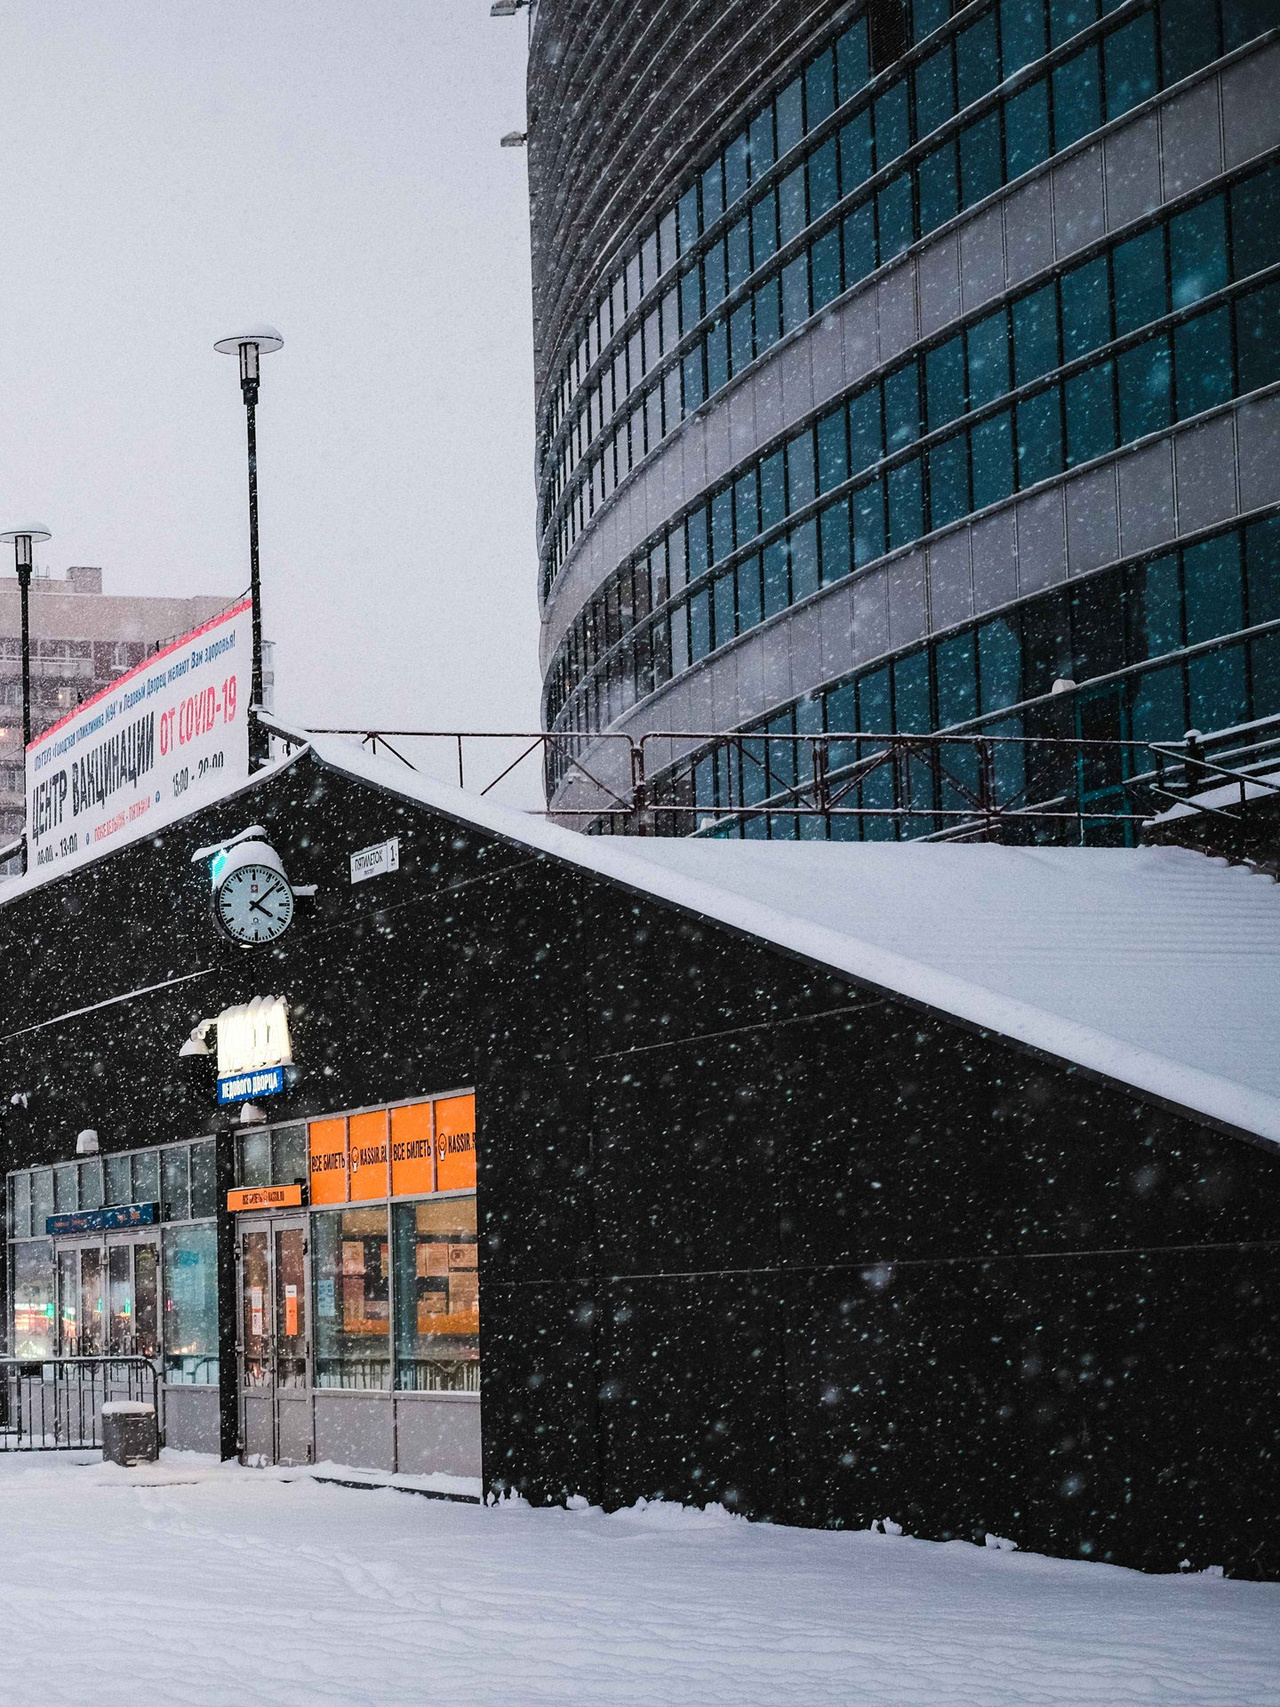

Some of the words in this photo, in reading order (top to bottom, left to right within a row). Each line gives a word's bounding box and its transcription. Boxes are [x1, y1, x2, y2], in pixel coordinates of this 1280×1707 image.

[123, 683, 145, 711] Ледовый
[147, 678, 166, 699] Дворец
[167, 658, 189, 683] желают
[191, 651, 203, 669] Вам
[204, 630, 235, 662] здоровья!
[32, 769, 67, 846] ЦЕНТР
[72, 711, 154, 818] ВАКЦИНАЦИИ
[160, 707, 175, 756] ОТ
[179, 676, 236, 745] COVID-19
[391, 845, 396, 861] 1
[222, 1077, 251, 1099] ЛЕДОВОГО
[252, 1072, 278, 1095] ДВОРЦА
[393, 1143, 405, 1161] ВСЕ
[312, 1155, 322, 1172] ВСЕ
